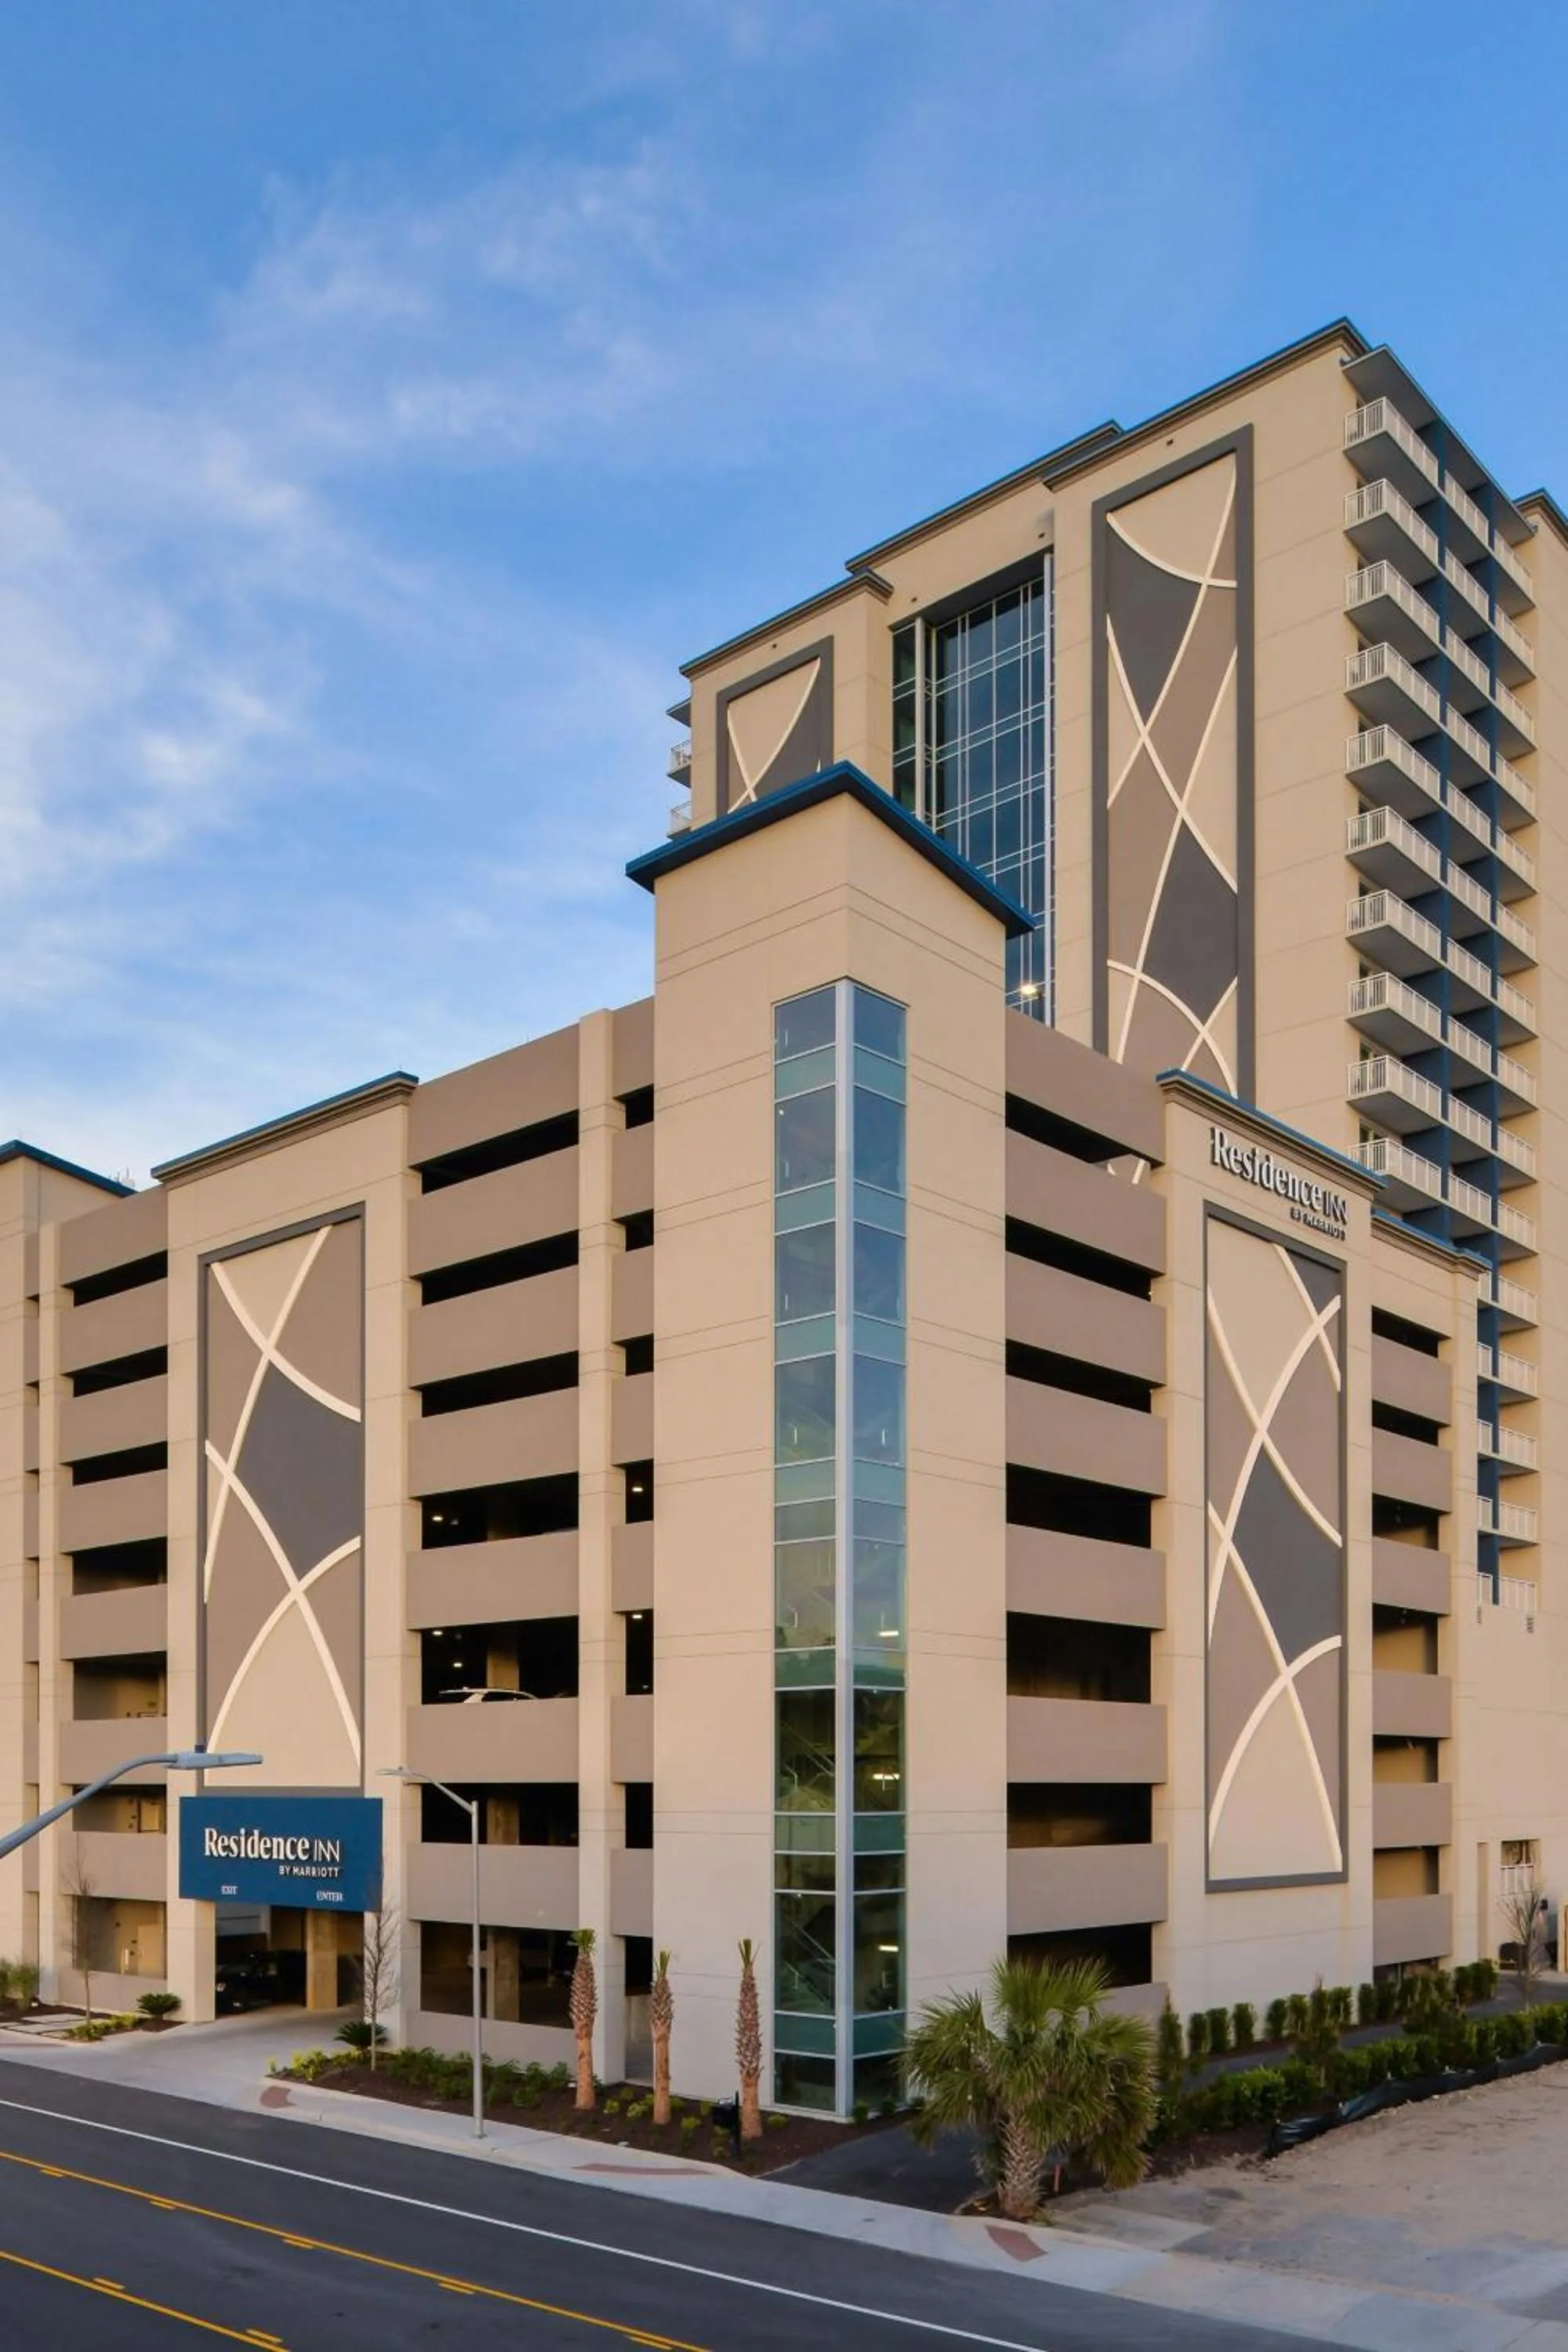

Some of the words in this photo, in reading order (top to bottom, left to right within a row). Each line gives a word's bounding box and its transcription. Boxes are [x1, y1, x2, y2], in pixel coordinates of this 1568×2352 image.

[1211, 1127, 1323, 1212] Residence
[1323, 1191, 1348, 1225] INN
[204, 1828, 310, 1860] Residence
[314, 1838, 339, 1863] INN
[279, 1865, 291, 1875] BY
[292, 1866, 339, 1878] MARRIOTT
[221, 1886, 238, 1895] EXIT
[316, 1890, 343, 1902] ENTER
